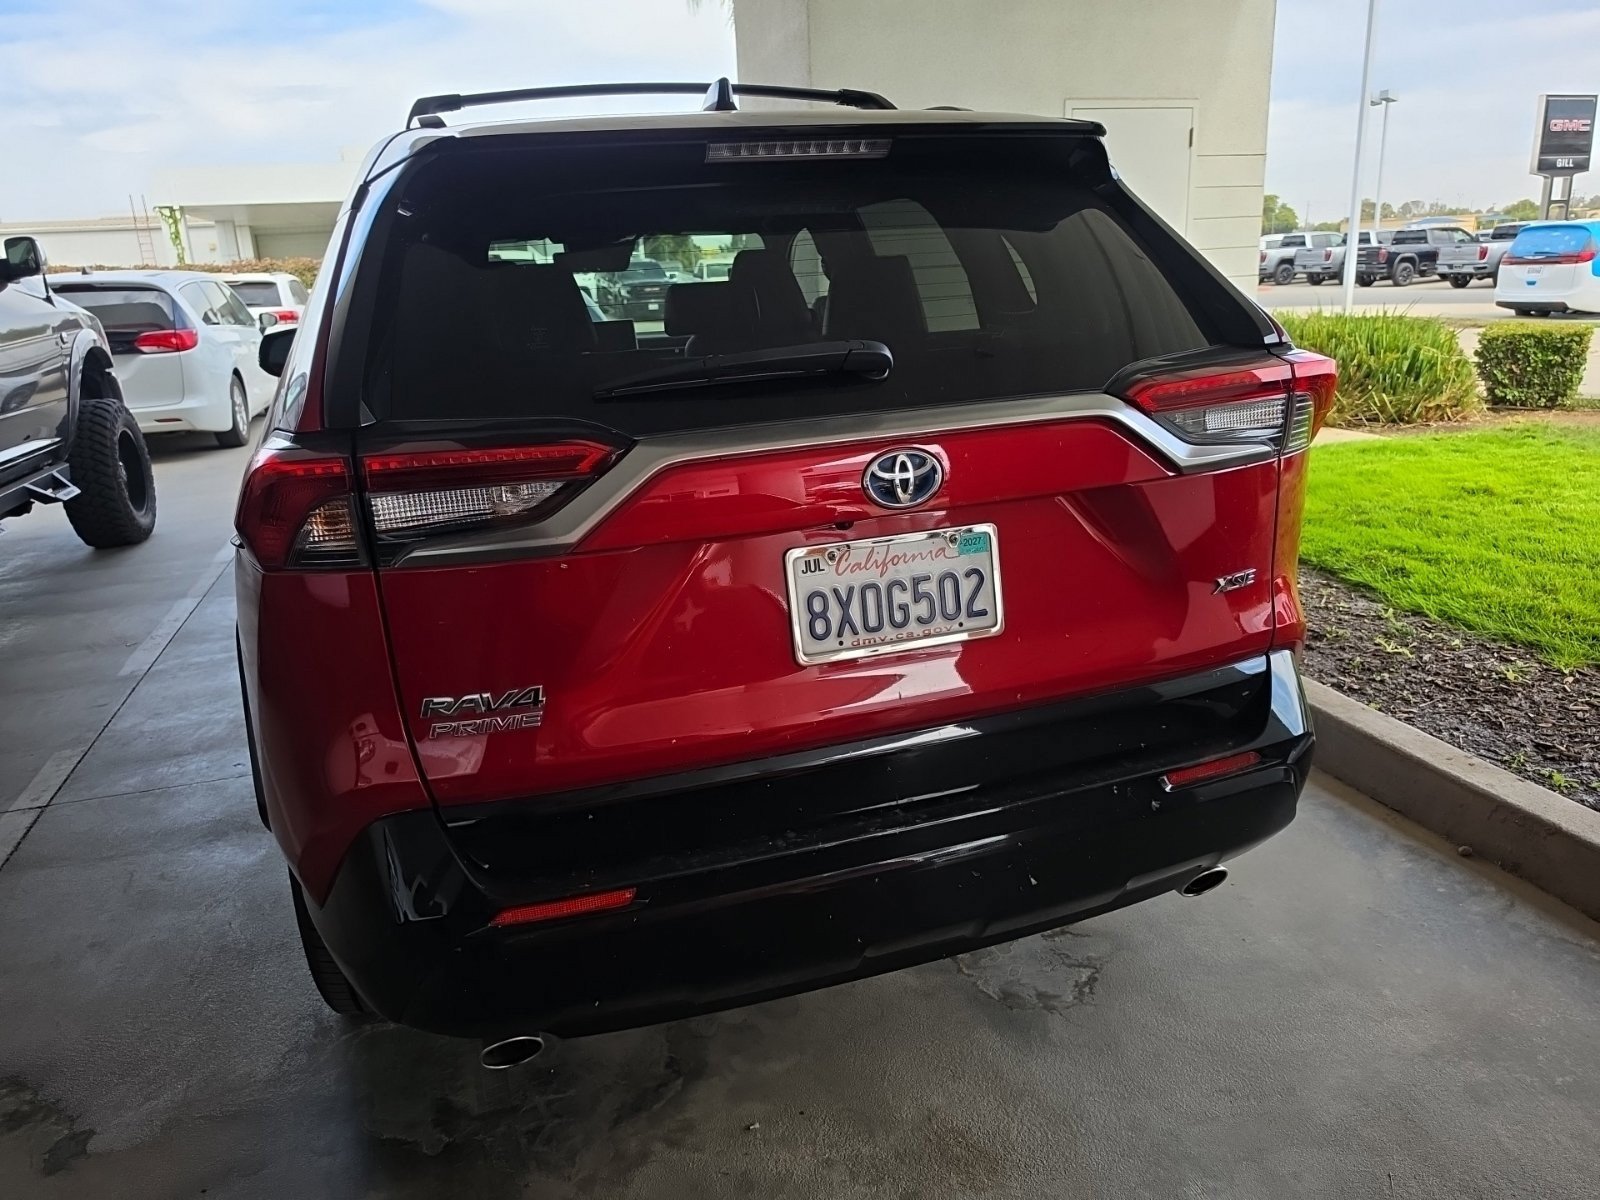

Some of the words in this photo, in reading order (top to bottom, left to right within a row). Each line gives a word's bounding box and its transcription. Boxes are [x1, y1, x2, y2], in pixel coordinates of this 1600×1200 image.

[1550, 119, 1591, 132] GMC
[1556, 158, 1574, 168] GILL
[963, 536, 982, 547] 2027
[801, 559, 825, 575] JUL
[834, 545, 951, 578] California
[1212, 568, 1257, 595] XSE
[851, 624, 955, 647] dmv.ca.gov
[420, 685, 546, 718] RAV4
[429, 711, 543, 739] PRIME
